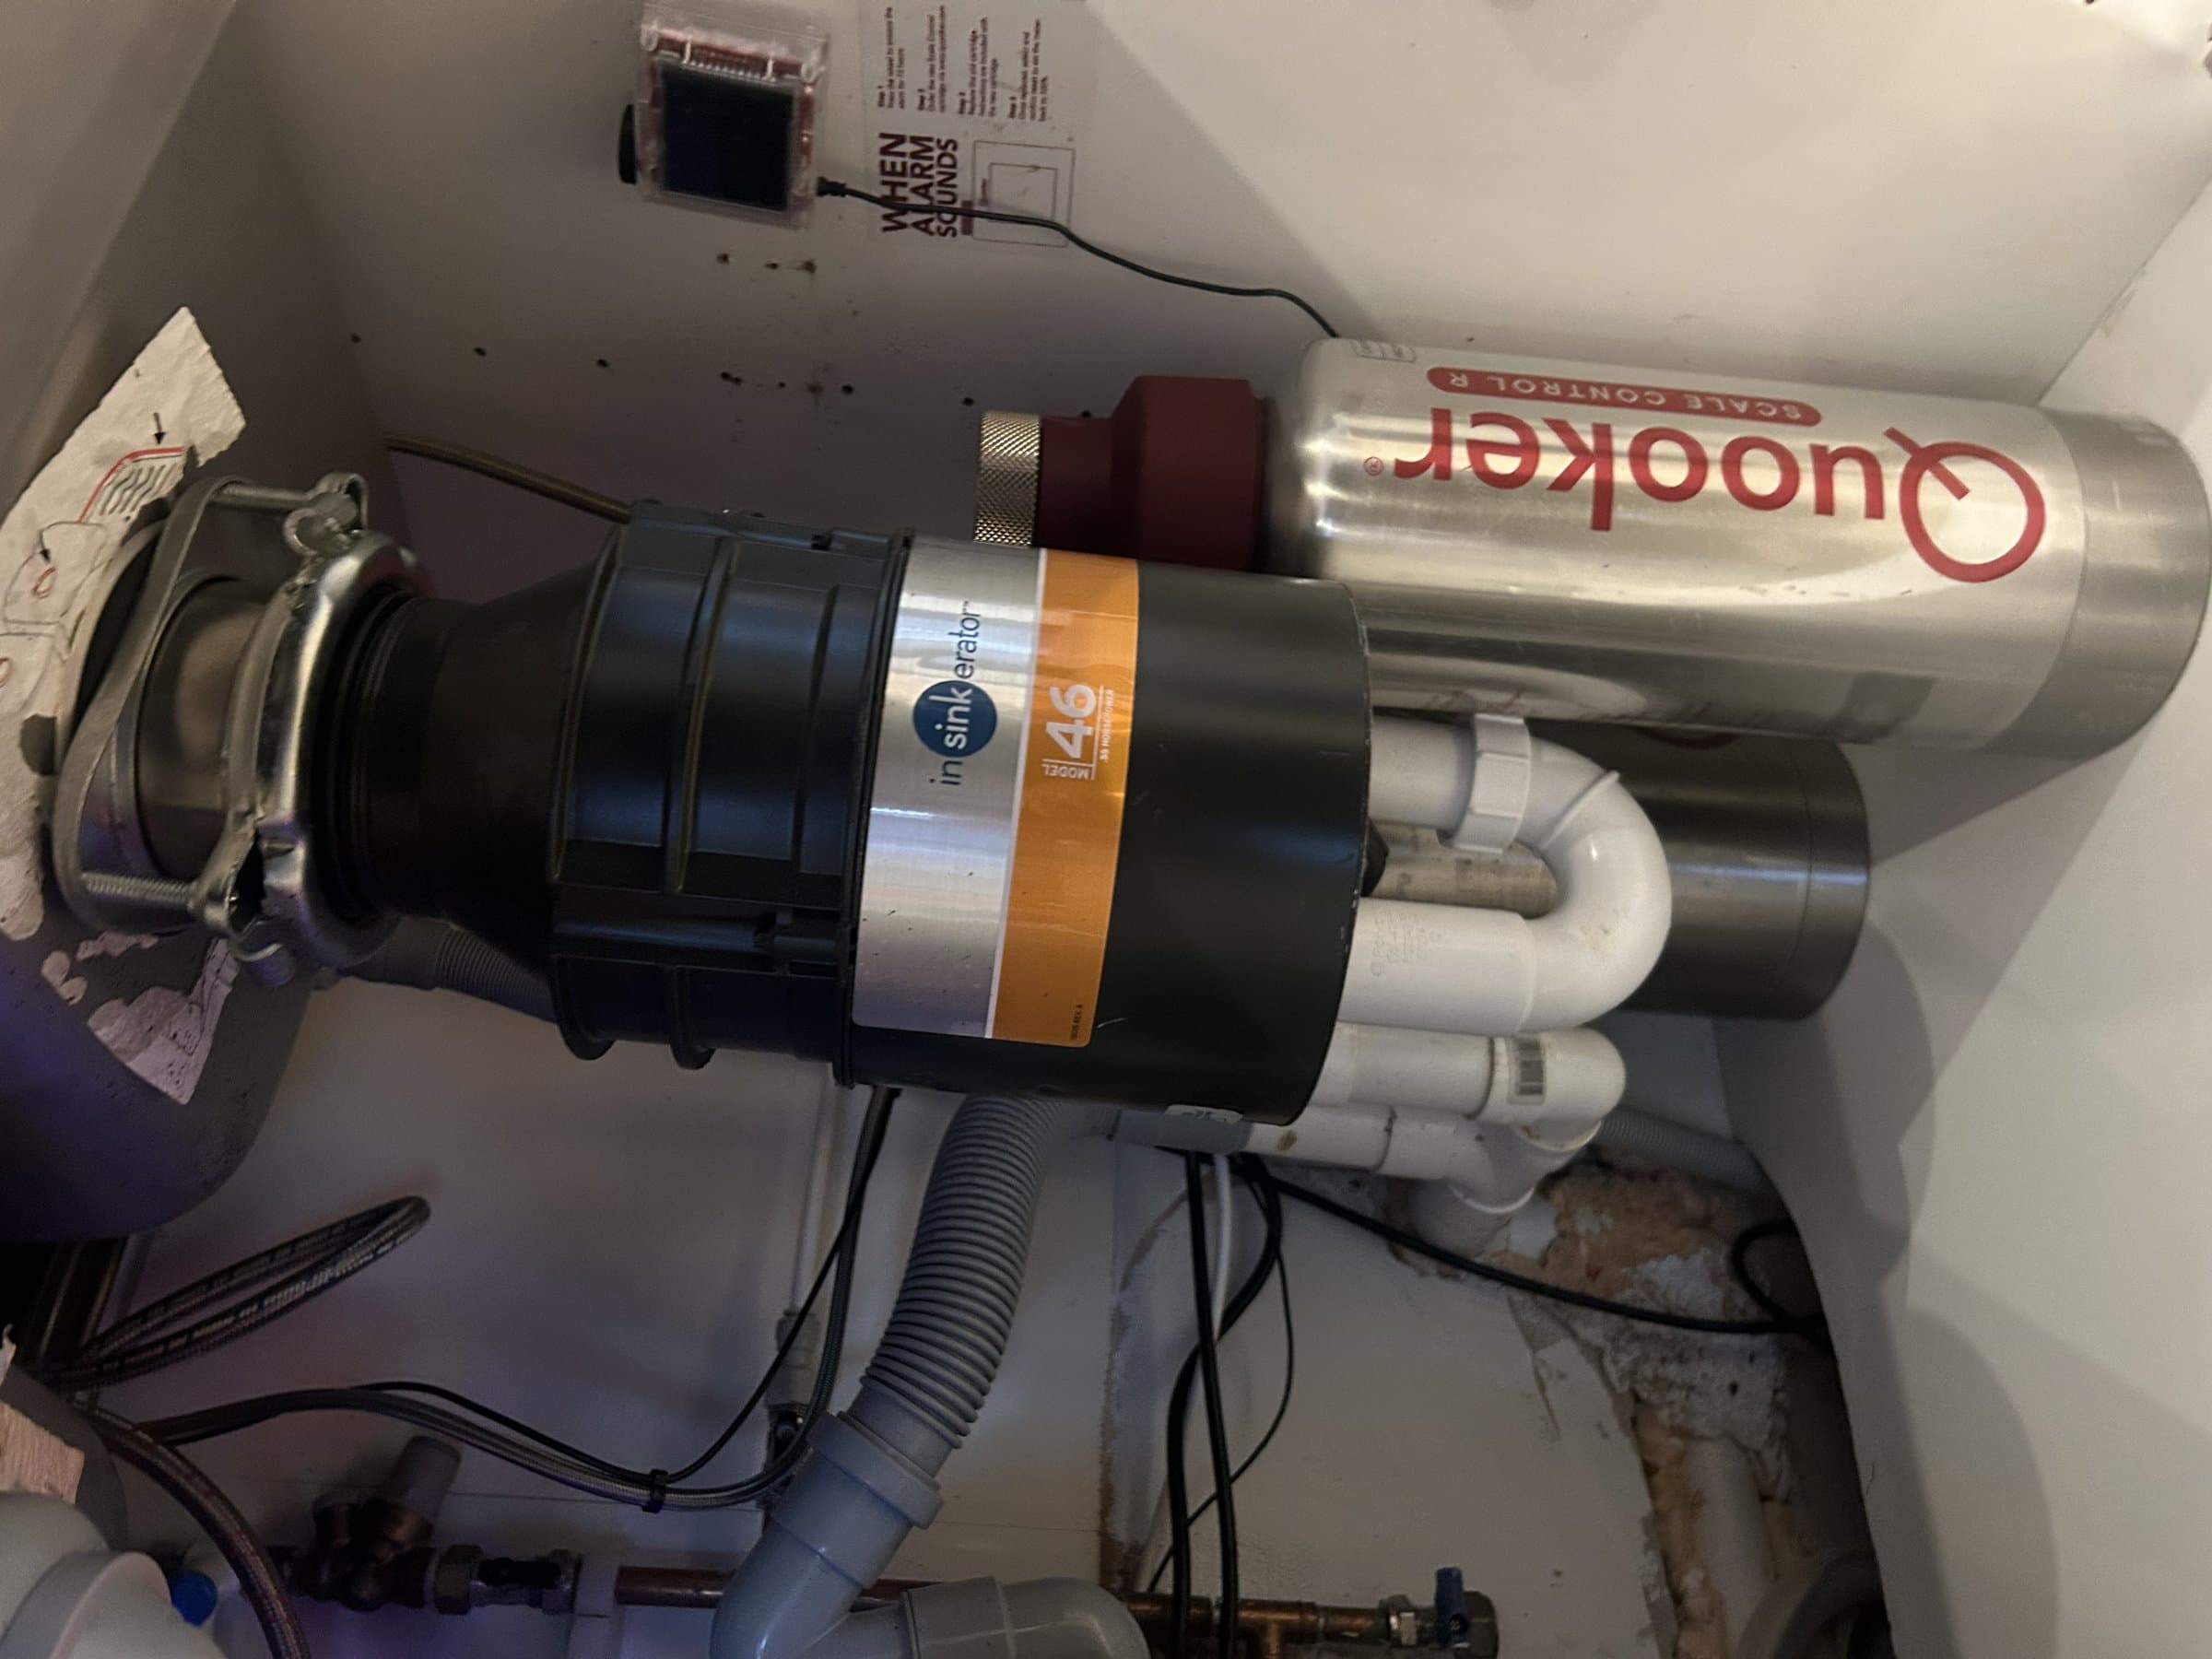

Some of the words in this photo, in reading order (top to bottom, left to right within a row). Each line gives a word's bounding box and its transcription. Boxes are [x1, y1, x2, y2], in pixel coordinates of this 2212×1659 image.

[878, 133, 908, 232] WHEN
[910, 135, 935, 237] AARM
[1449, 372, 1468, 388] R
[1487, 376, 1664, 405] CONTROL
[1686, 394, 1802, 420] SCALE
[1394, 407, 2045, 582] Quooker
[1045, 684, 1097, 759] 46
[1041, 764, 1089, 780] MODEL
